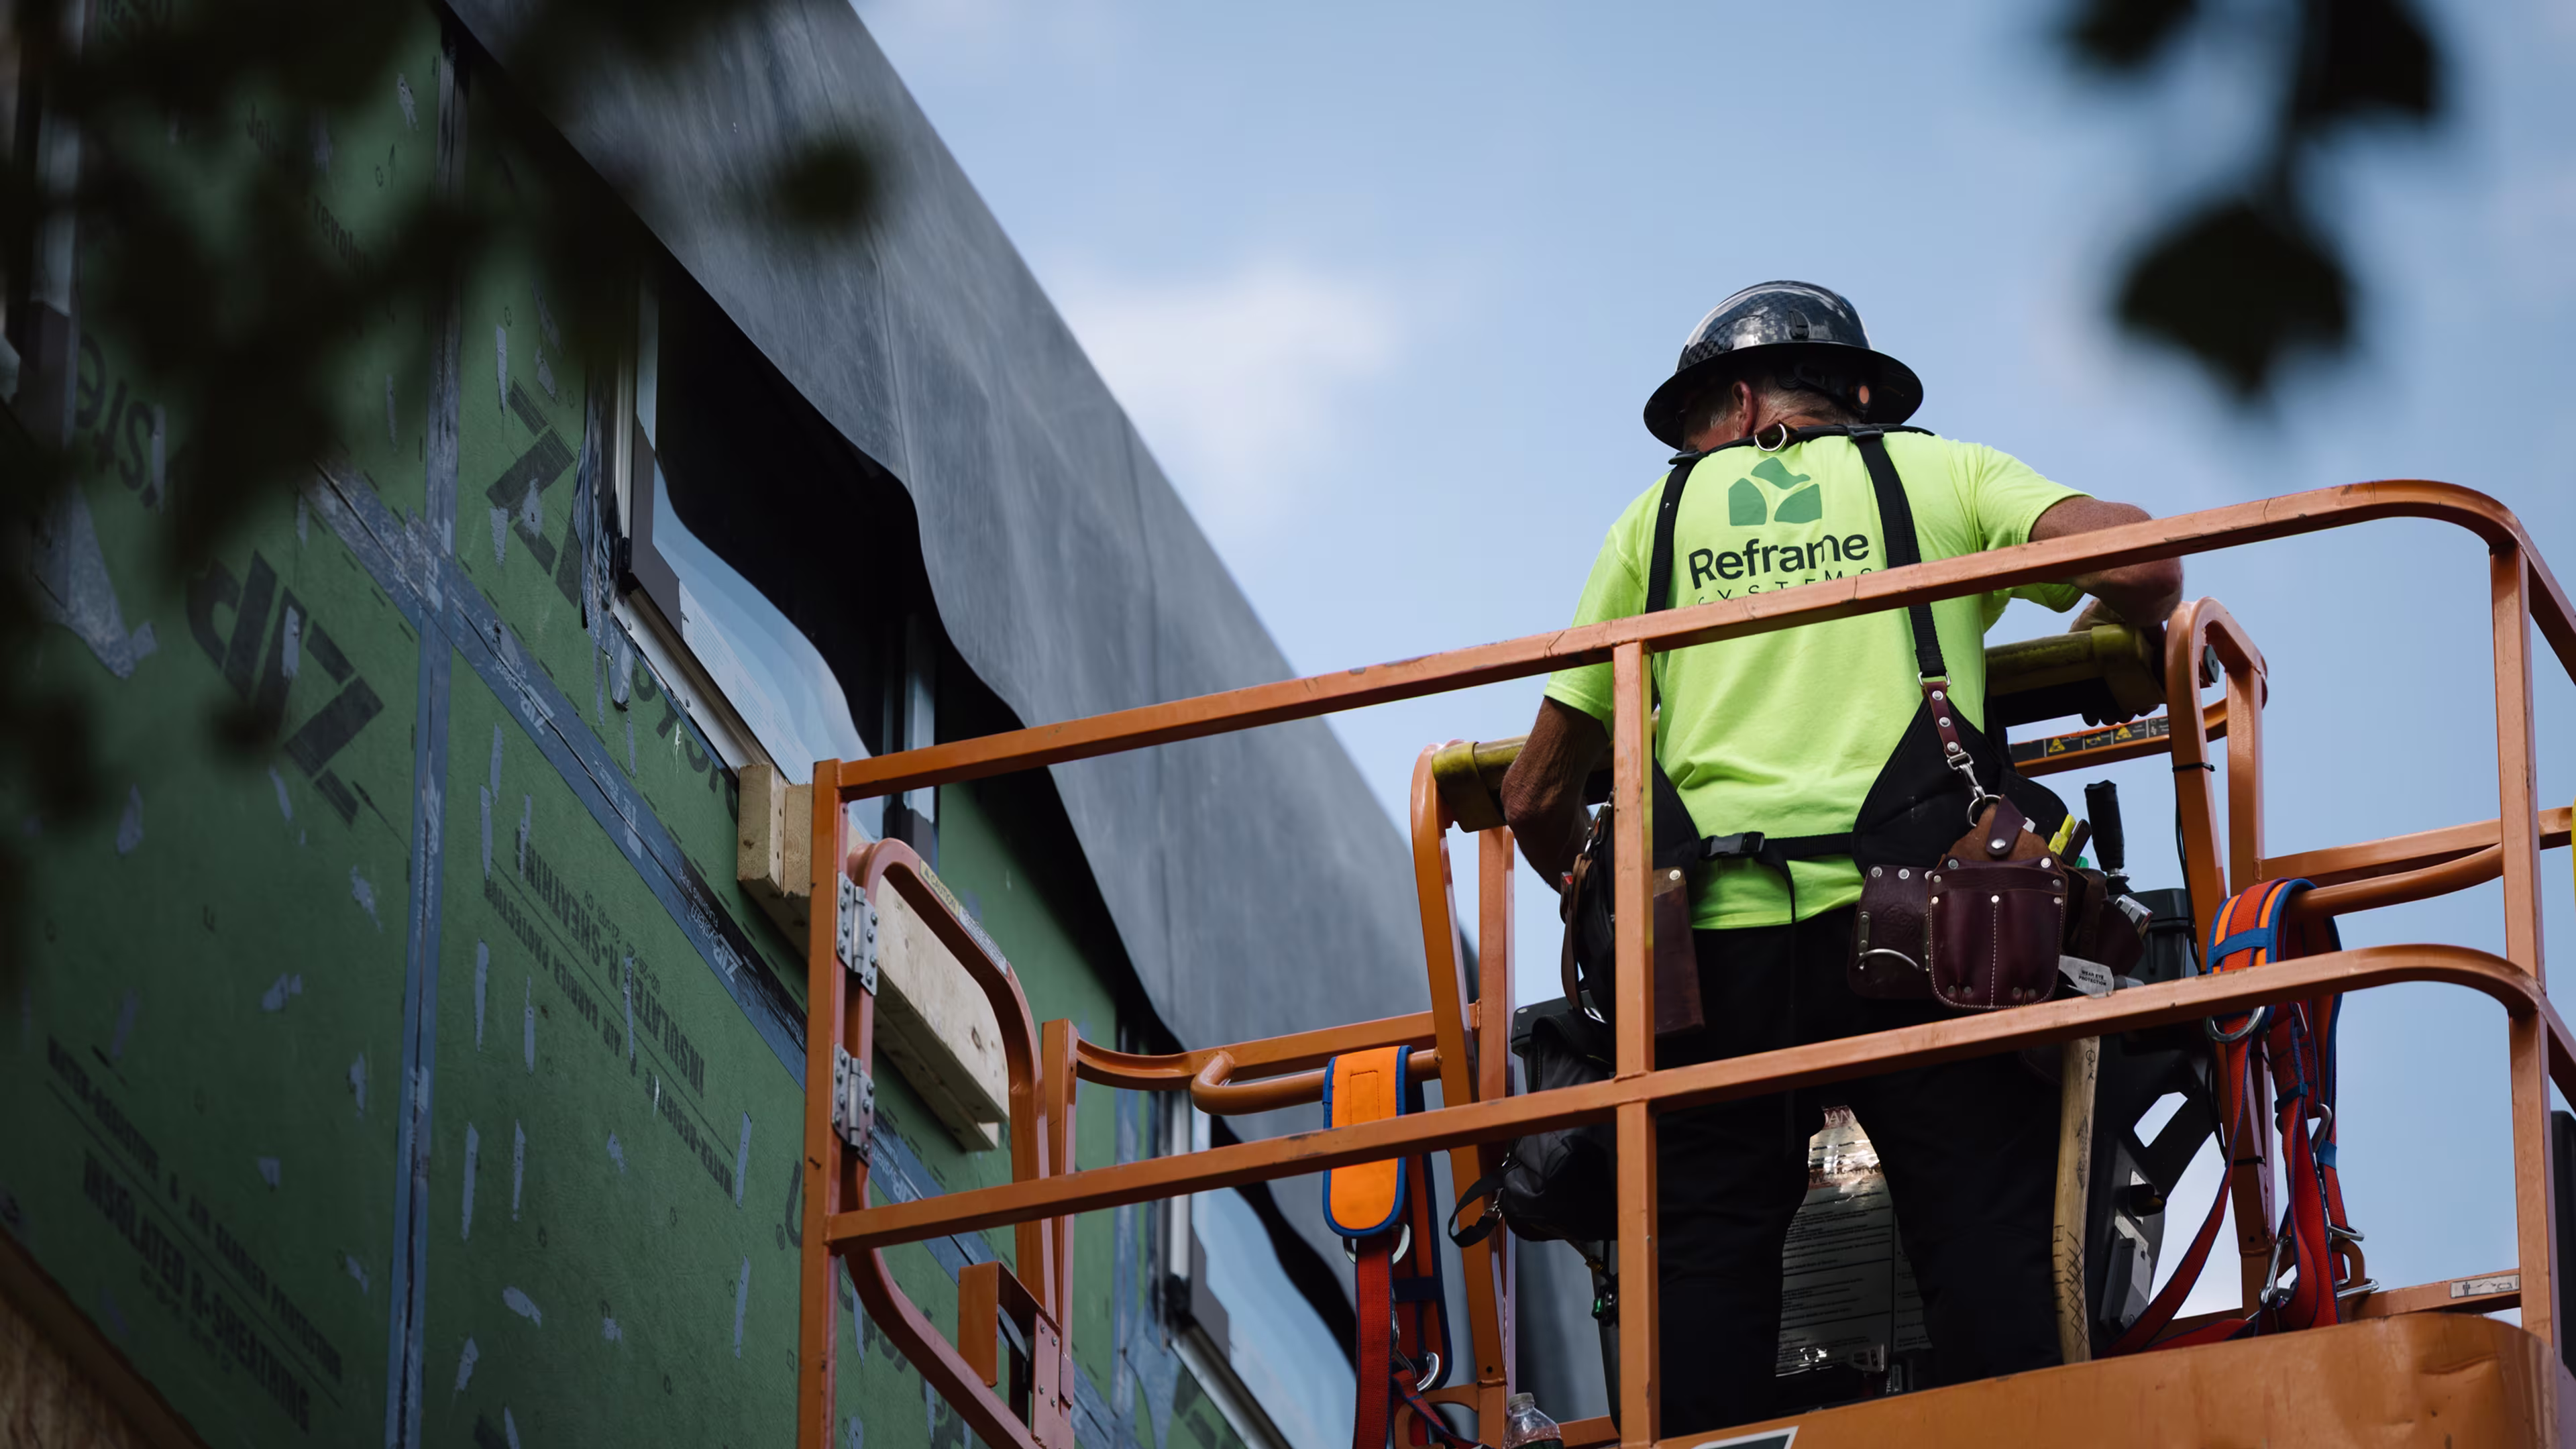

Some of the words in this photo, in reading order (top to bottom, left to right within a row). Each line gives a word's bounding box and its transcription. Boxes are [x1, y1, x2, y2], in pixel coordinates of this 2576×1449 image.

[1688, 534, 1870, 590] Reframe
[678, 867, 692, 894] TAPE
[483, 877, 550, 973] PROTECTION
[690, 903, 719, 949] system
[693, 887, 718, 928] FLASHING
[713, 944, 739, 984] ZIP
[2078, 975, 2106, 986] PROTECTION
[552, 955, 599, 1031] BARRIER
[602, 1017, 622, 1058] AIR
